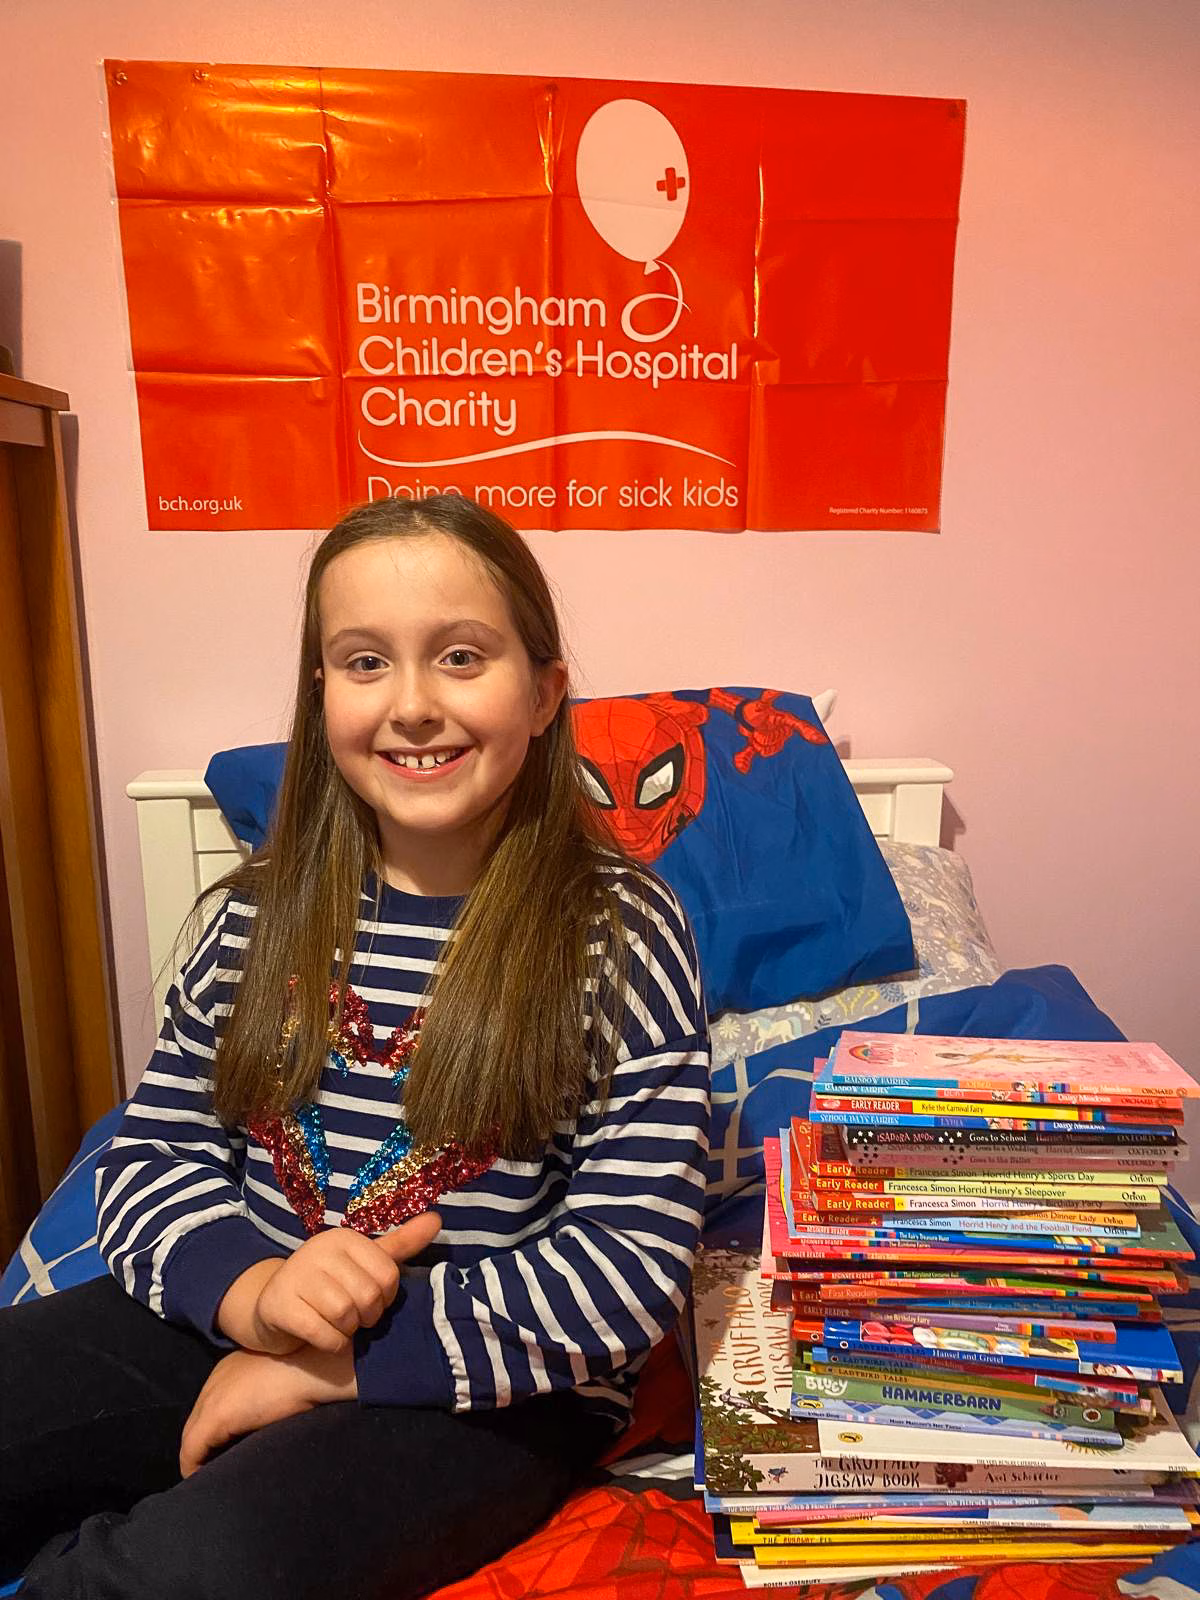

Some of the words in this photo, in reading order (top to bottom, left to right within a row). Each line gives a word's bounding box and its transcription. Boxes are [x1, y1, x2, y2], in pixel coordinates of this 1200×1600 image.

[356, 282, 606, 336] Birmingham
[358, 335, 563, 377] Children's
[576, 339, 738, 389] Hospital
[360, 386, 517, 436] Charity
[475, 483, 556, 507] more
[566, 479, 608, 507] for
[618, 477, 674, 507] sick
[682, 477, 738, 507] kids
[159, 495, 243, 514] bch.org.uk
[859, 507, 879, 515] Charity
[1058, 1093, 1077, 1103] Daisy
[1077, 1094, 1111, 1102] Meadows
[851, 1100, 871, 1110] EARLY
[873, 1101, 900, 1111] READER
[921, 1103, 935, 1112] Kylie
[947, 1104, 969, 1113] Carnival
[970, 1105, 984, 1114] Fairy
[820, 1113, 847, 1122] SCHOOL
[849, 1115, 871, 1123] DAYS
[871, 1116, 899, 1125] FAIRIES
[1053, 1122, 1074, 1131] Daisy
[969, 1133, 989, 1142] Goes
[990, 1133, 998, 1142] to
[1000, 1133, 1027, 1142] School
[827, 1164, 851, 1175] Early
[855, 1165, 889, 1175] Reader
[910, 1167, 949, 1176] Francesca
[951, 1168, 977, 1176] Simon
[982, 1169, 1011, 1178] Horrid
[1014, 1171, 1045, 1181] Henry's
[1048, 1172, 1075, 1181] Sports
[1078, 1173, 1095, 1182] Day
[1130, 1173, 1154, 1183] Orion
[816, 1179, 840, 1191] Early
[844, 1181, 878, 1190] Reader
[888, 1183, 928, 1192] Francesca
[930, 1184, 956, 1193] Simon
[958, 1185, 987, 1194] Horrid
[990, 1186, 1022, 1197] Henry's
[1025, 1188, 1067, 1198] Sleepover
[1122, 1191, 1146, 1201] Orion
[827, 1200, 852, 1211] Early
[855, 1200, 890, 1209] Reader
[910, 1200, 949, 1208] Francesca
[951, 1200, 976, 1208] Simon
[981, 1200, 1009, 1208] Horrid
[1012, 1200, 1043, 1210] Henry's
[1046, 1199, 1079, 1208] Birthday
[1081, 1200, 1103, 1209] Party
[802, 1213, 825, 1223] Early
[828, 1214, 859, 1223] Reader
[1051, 1211, 1077, 1221] Dinner
[1079, 1213, 1097, 1223] Lady
[1103, 1216, 1124, 1225] Orion
[892, 1217, 928, 1227] Francesca
[930, 1219, 952, 1227] Simon
[959, 1219, 984, 1229] Horrid
[986, 1220, 1008, 1231] Henry
[1011, 1222, 1024, 1231] and
[1026, 1223, 1038, 1231] the
[1040, 1223, 1070, 1233] Football
[1072, 1225, 1092, 1233] Fiend
[1103, 1226, 1128, 1236] Orion
[828, 1288, 844, 1298] First
[846, 1287, 878, 1297] Readers
[803, 1306, 822, 1315] EARLY
[824, 1307, 850, 1316] READER
[894, 1314, 916, 1323] Birthday
[722, 1285, 767, 1386] GRUFFALO
[843, 1357, 886, 1367] LADYBIRD
[888, 1360, 914, 1368] TALES
[933, 1350, 960, 1359] Hansel
[963, 1352, 977, 1361] and
[979, 1354, 1004, 1364] Gretel
[838, 1368, 880, 1380] LADYBIRD
[884, 1373, 908, 1382] TALES
[882, 1386, 1001, 1411] HAMMERBARN
[838, 1457, 920, 1471] GRUFFALO
[813, 1474, 875, 1489] JIGSAW
[883, 1473, 920, 1488] BOOK
[985, 1472, 1006, 1482] Axel
